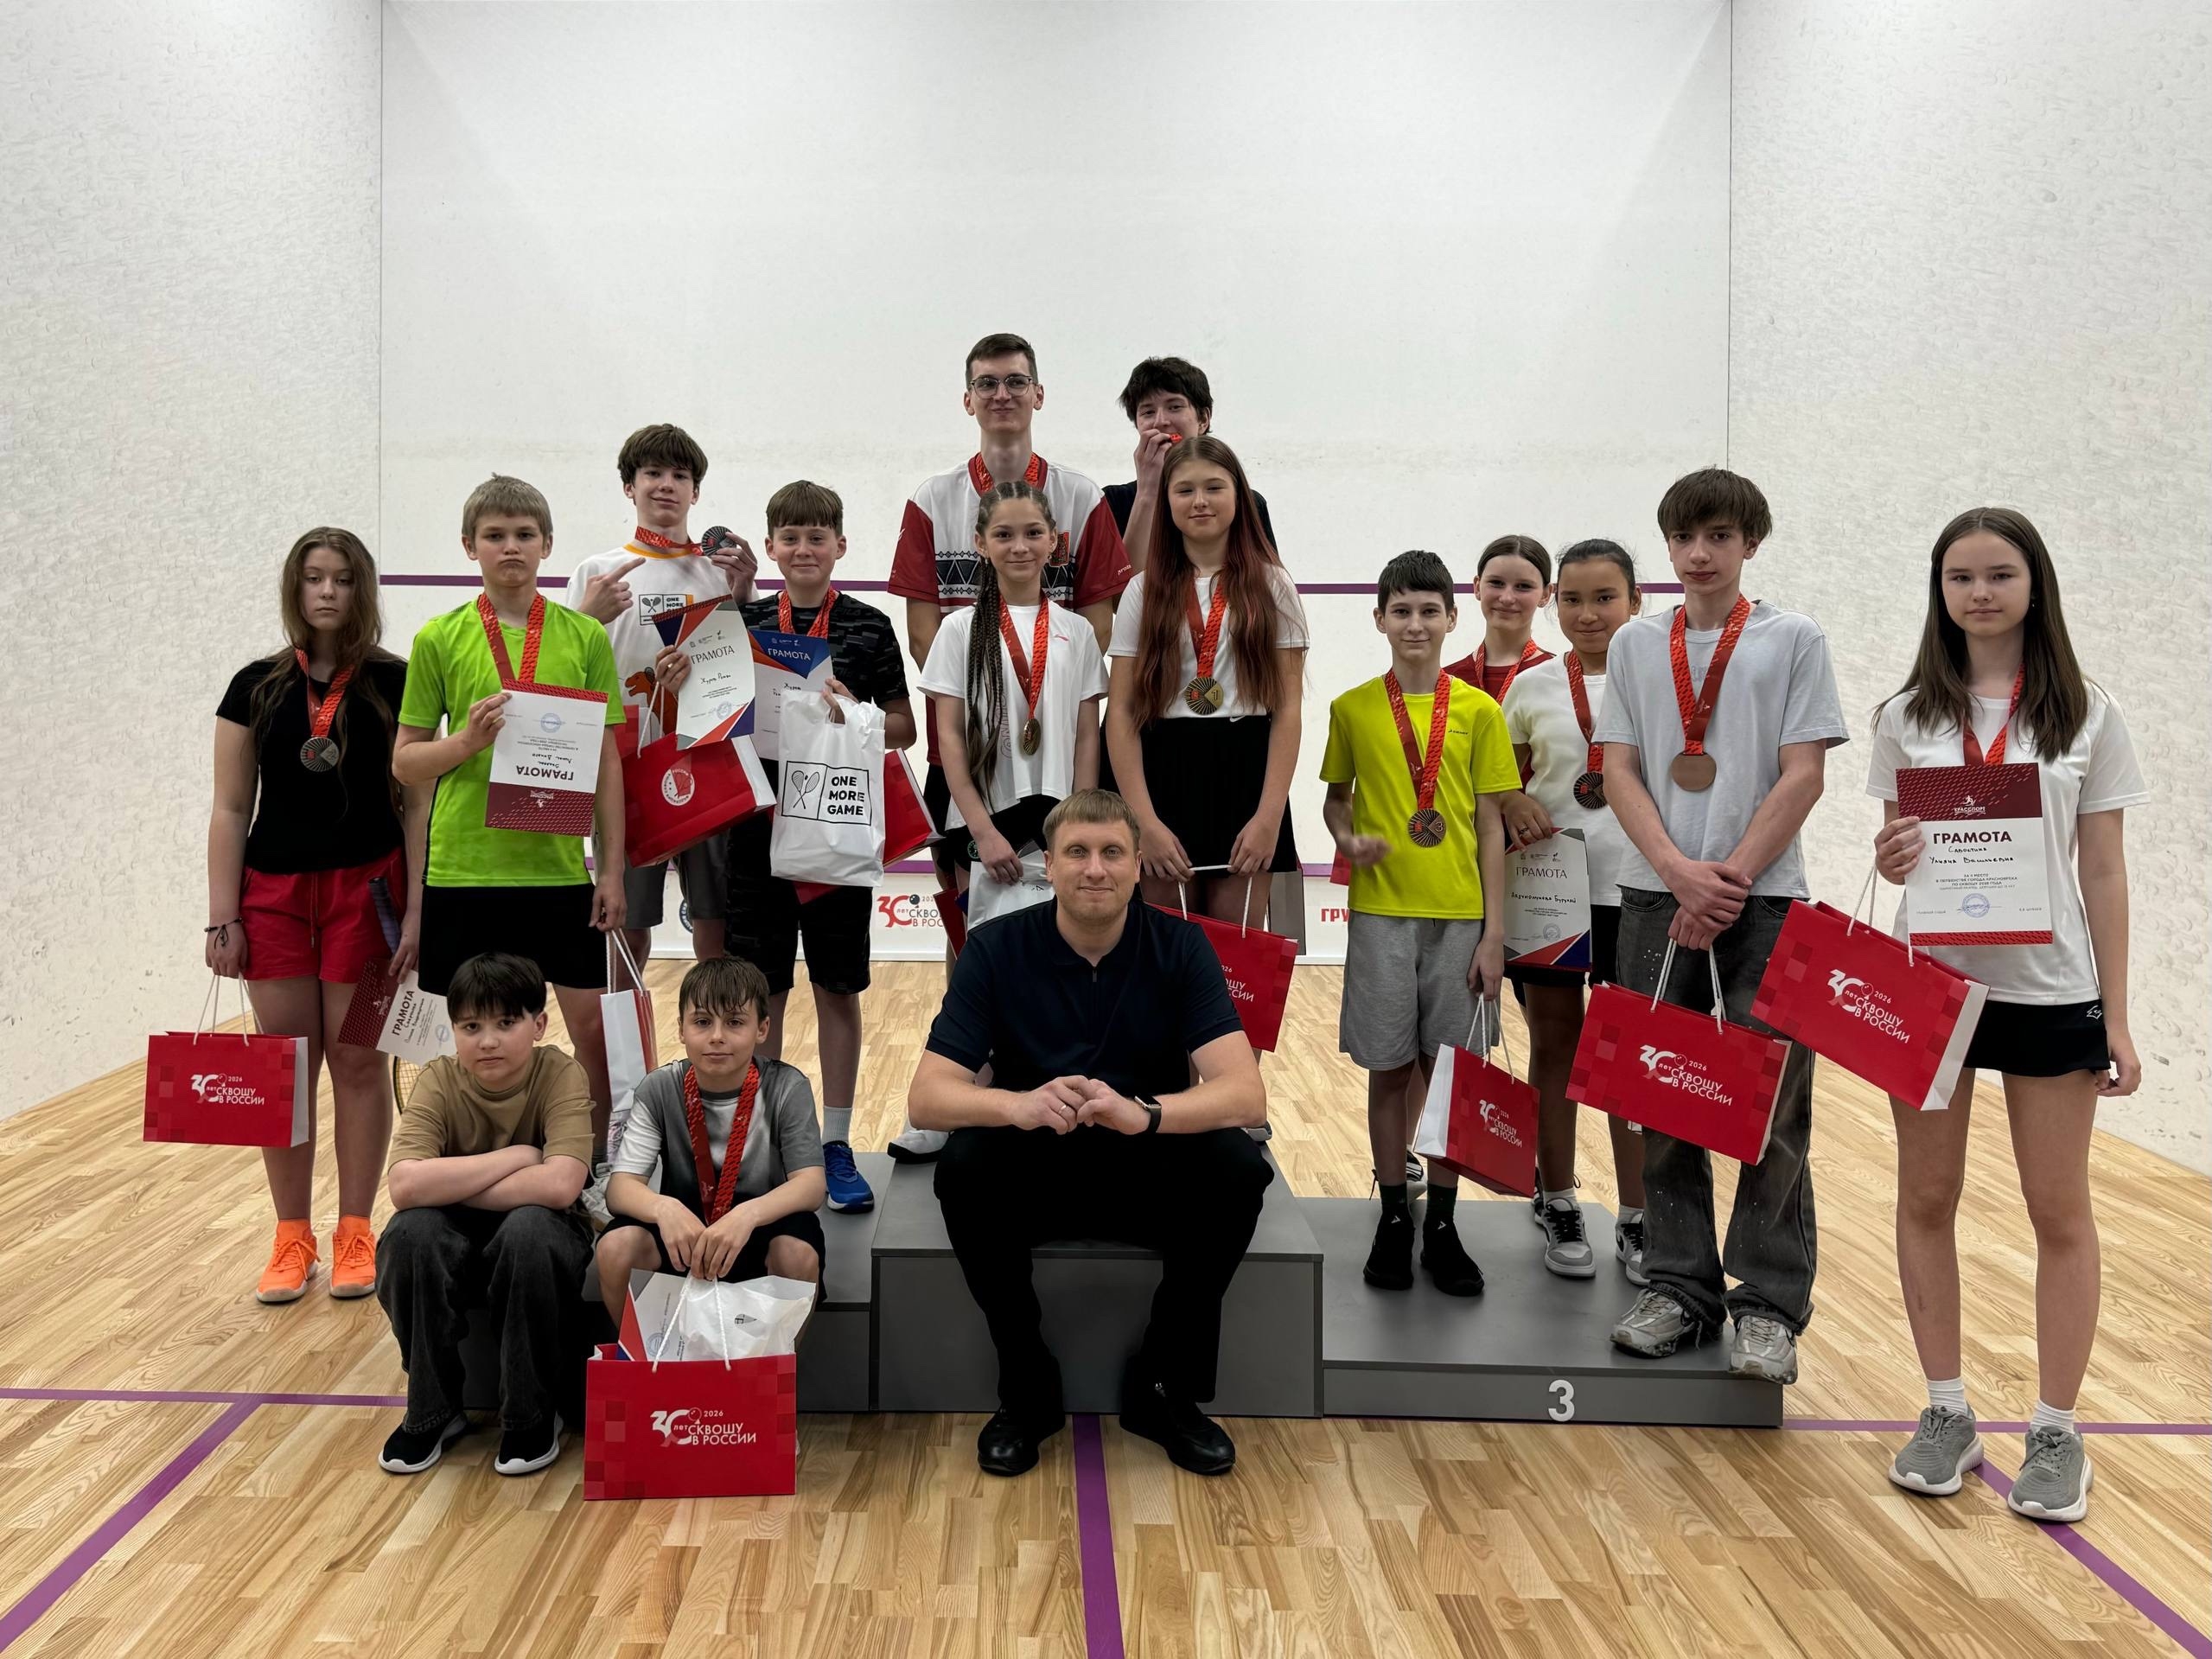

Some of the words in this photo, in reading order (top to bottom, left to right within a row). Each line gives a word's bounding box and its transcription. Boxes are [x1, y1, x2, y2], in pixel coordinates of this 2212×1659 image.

[692, 645, 736, 665] ГРАМОТА
[765, 648, 812, 661] ГРАМОТА
[516, 765, 574, 781] ГРАМОТА
[832, 775, 857, 786] ONE
[829, 790, 864, 802] MORE
[827, 805, 864, 815] GAME
[1435, 821, 1444, 833] 3
[1933, 831, 2012, 844] ГРАМОТА
[1515, 866, 1568, 879] ГРАМОТА
[909, 909, 940, 918] СКВО
[1321, 908, 1349, 922] ГРУ
[921, 918, 944, 928] РОС
[1227, 987, 1254, 1002] СИИ
[1874, 991, 1891, 1004] 2026
[392, 990, 415, 1036] ГРАМОТА
[1845, 990, 1857, 1000] лет
[1855, 997, 1903, 1027] СКВОШУ
[1854, 1008, 1862, 1018] В
[1863, 1012, 1910, 1043] РОССИИ
[1688, 1060, 1707, 1071] 2026
[1658, 1062, 1672, 1071] лет
[1671, 1068, 1723, 1092] СКВОШУ
[216, 1087, 257, 1096] СКВОШУ
[1672, 1078, 1679, 1088] В
[1681, 1081, 1733, 1107] РОССИИ
[219, 1095, 224, 1104] В
[226, 1095, 265, 1105] РОССИИ
[1548, 1379, 1575, 1422] 3
[688, 1422, 744, 1436] СКВОШУ
[692, 1435, 699, 1445] В
[703, 1432, 757, 1445] РОССИИ
